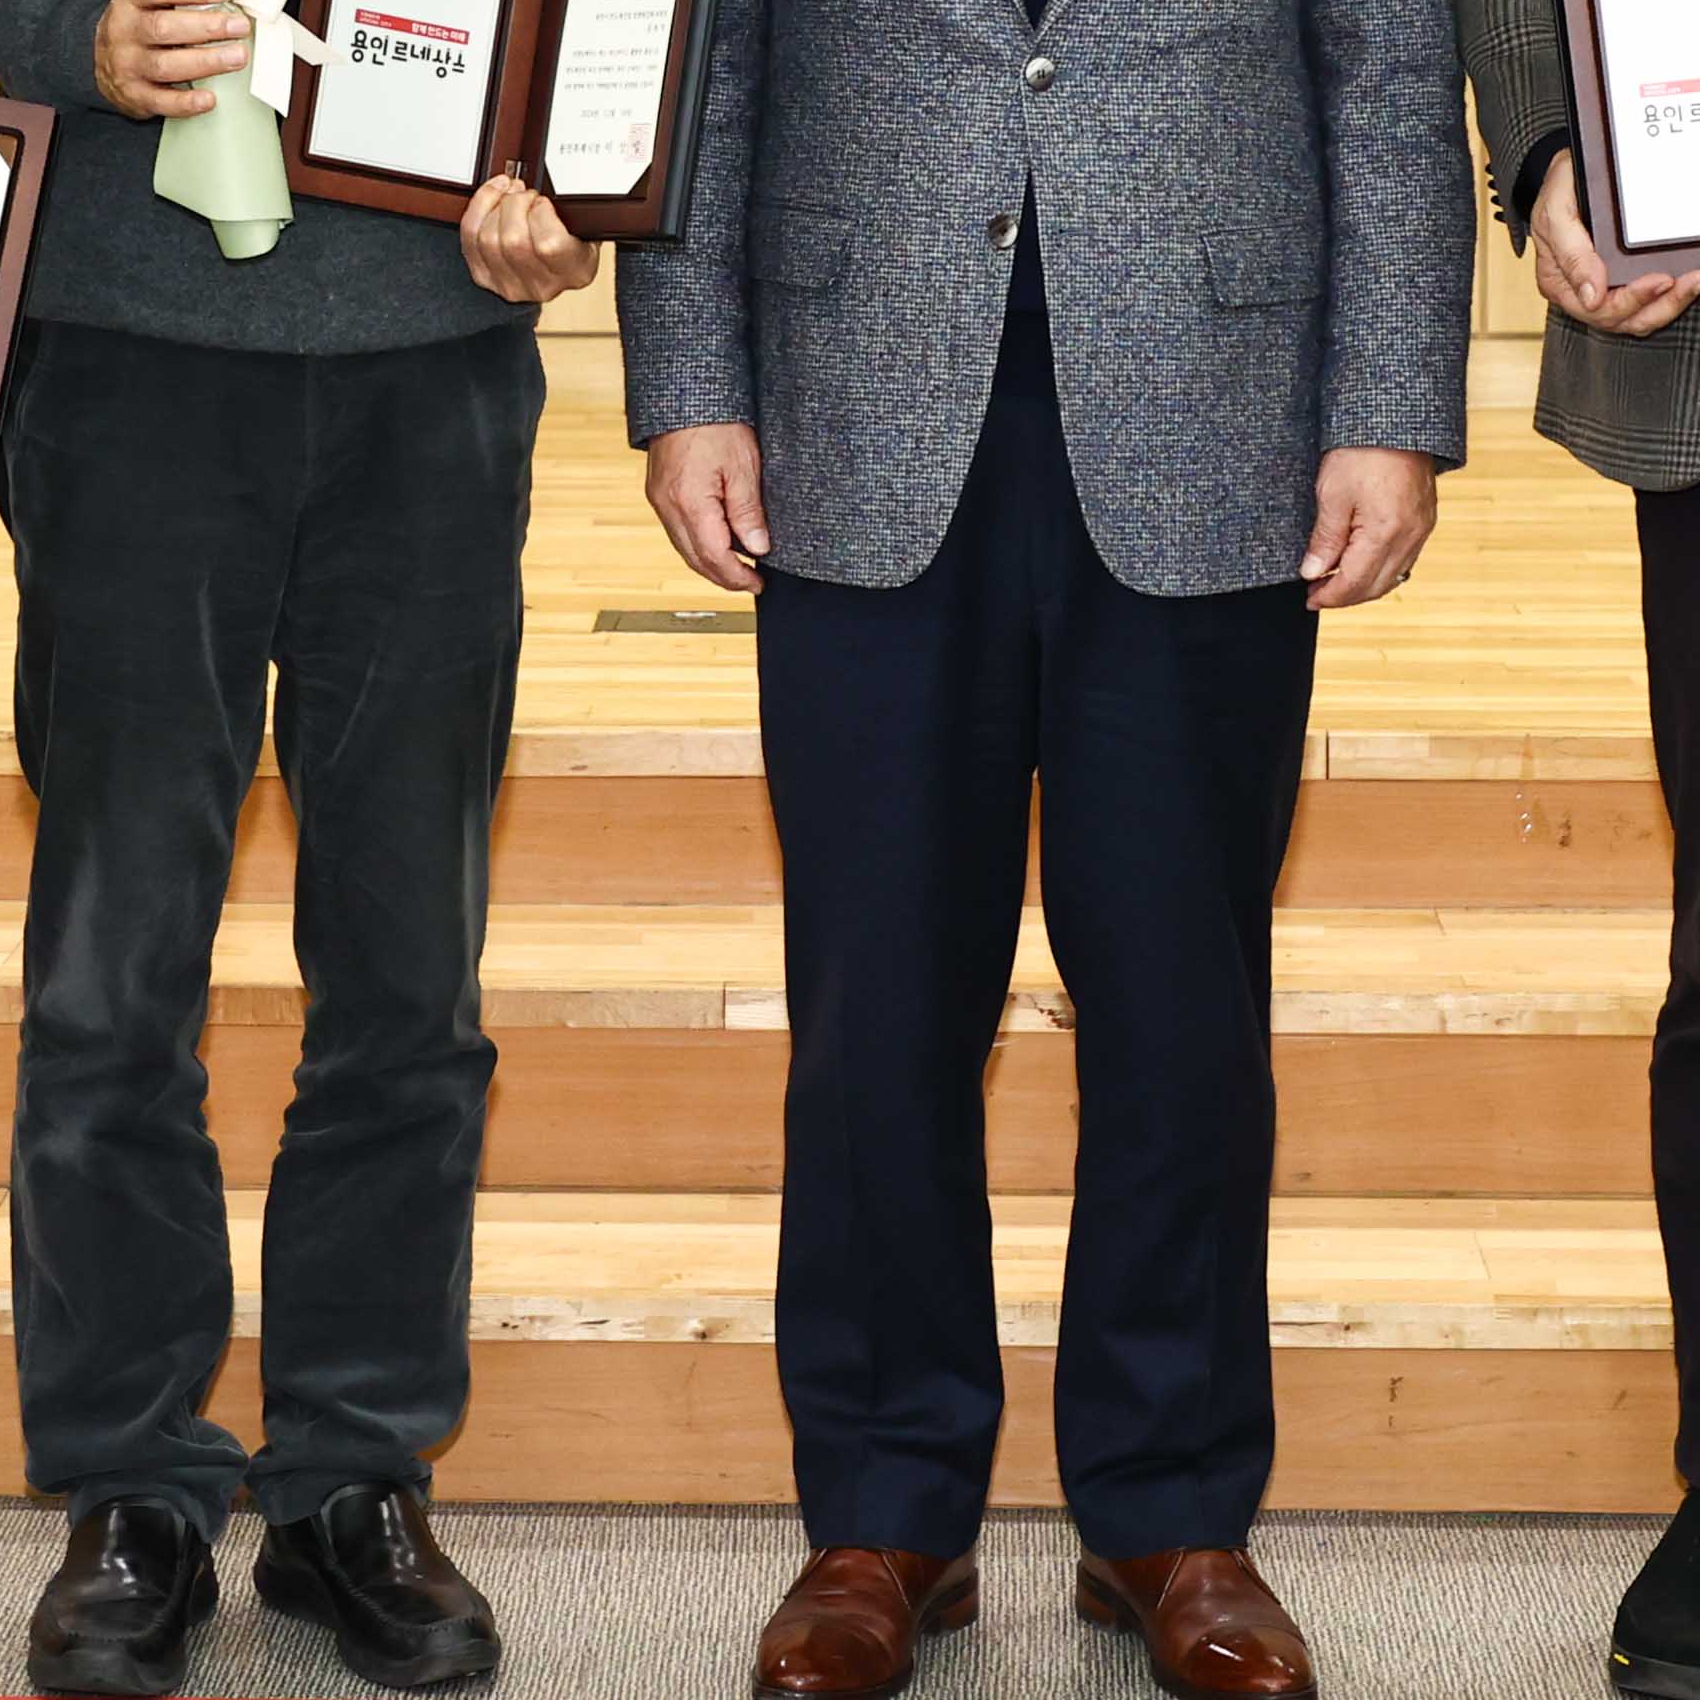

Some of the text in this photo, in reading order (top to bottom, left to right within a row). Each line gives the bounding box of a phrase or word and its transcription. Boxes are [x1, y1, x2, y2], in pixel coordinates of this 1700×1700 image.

[350, 29, 465, 79] 용인 르네상스
[1643, 104, 1683, 138] 용인
